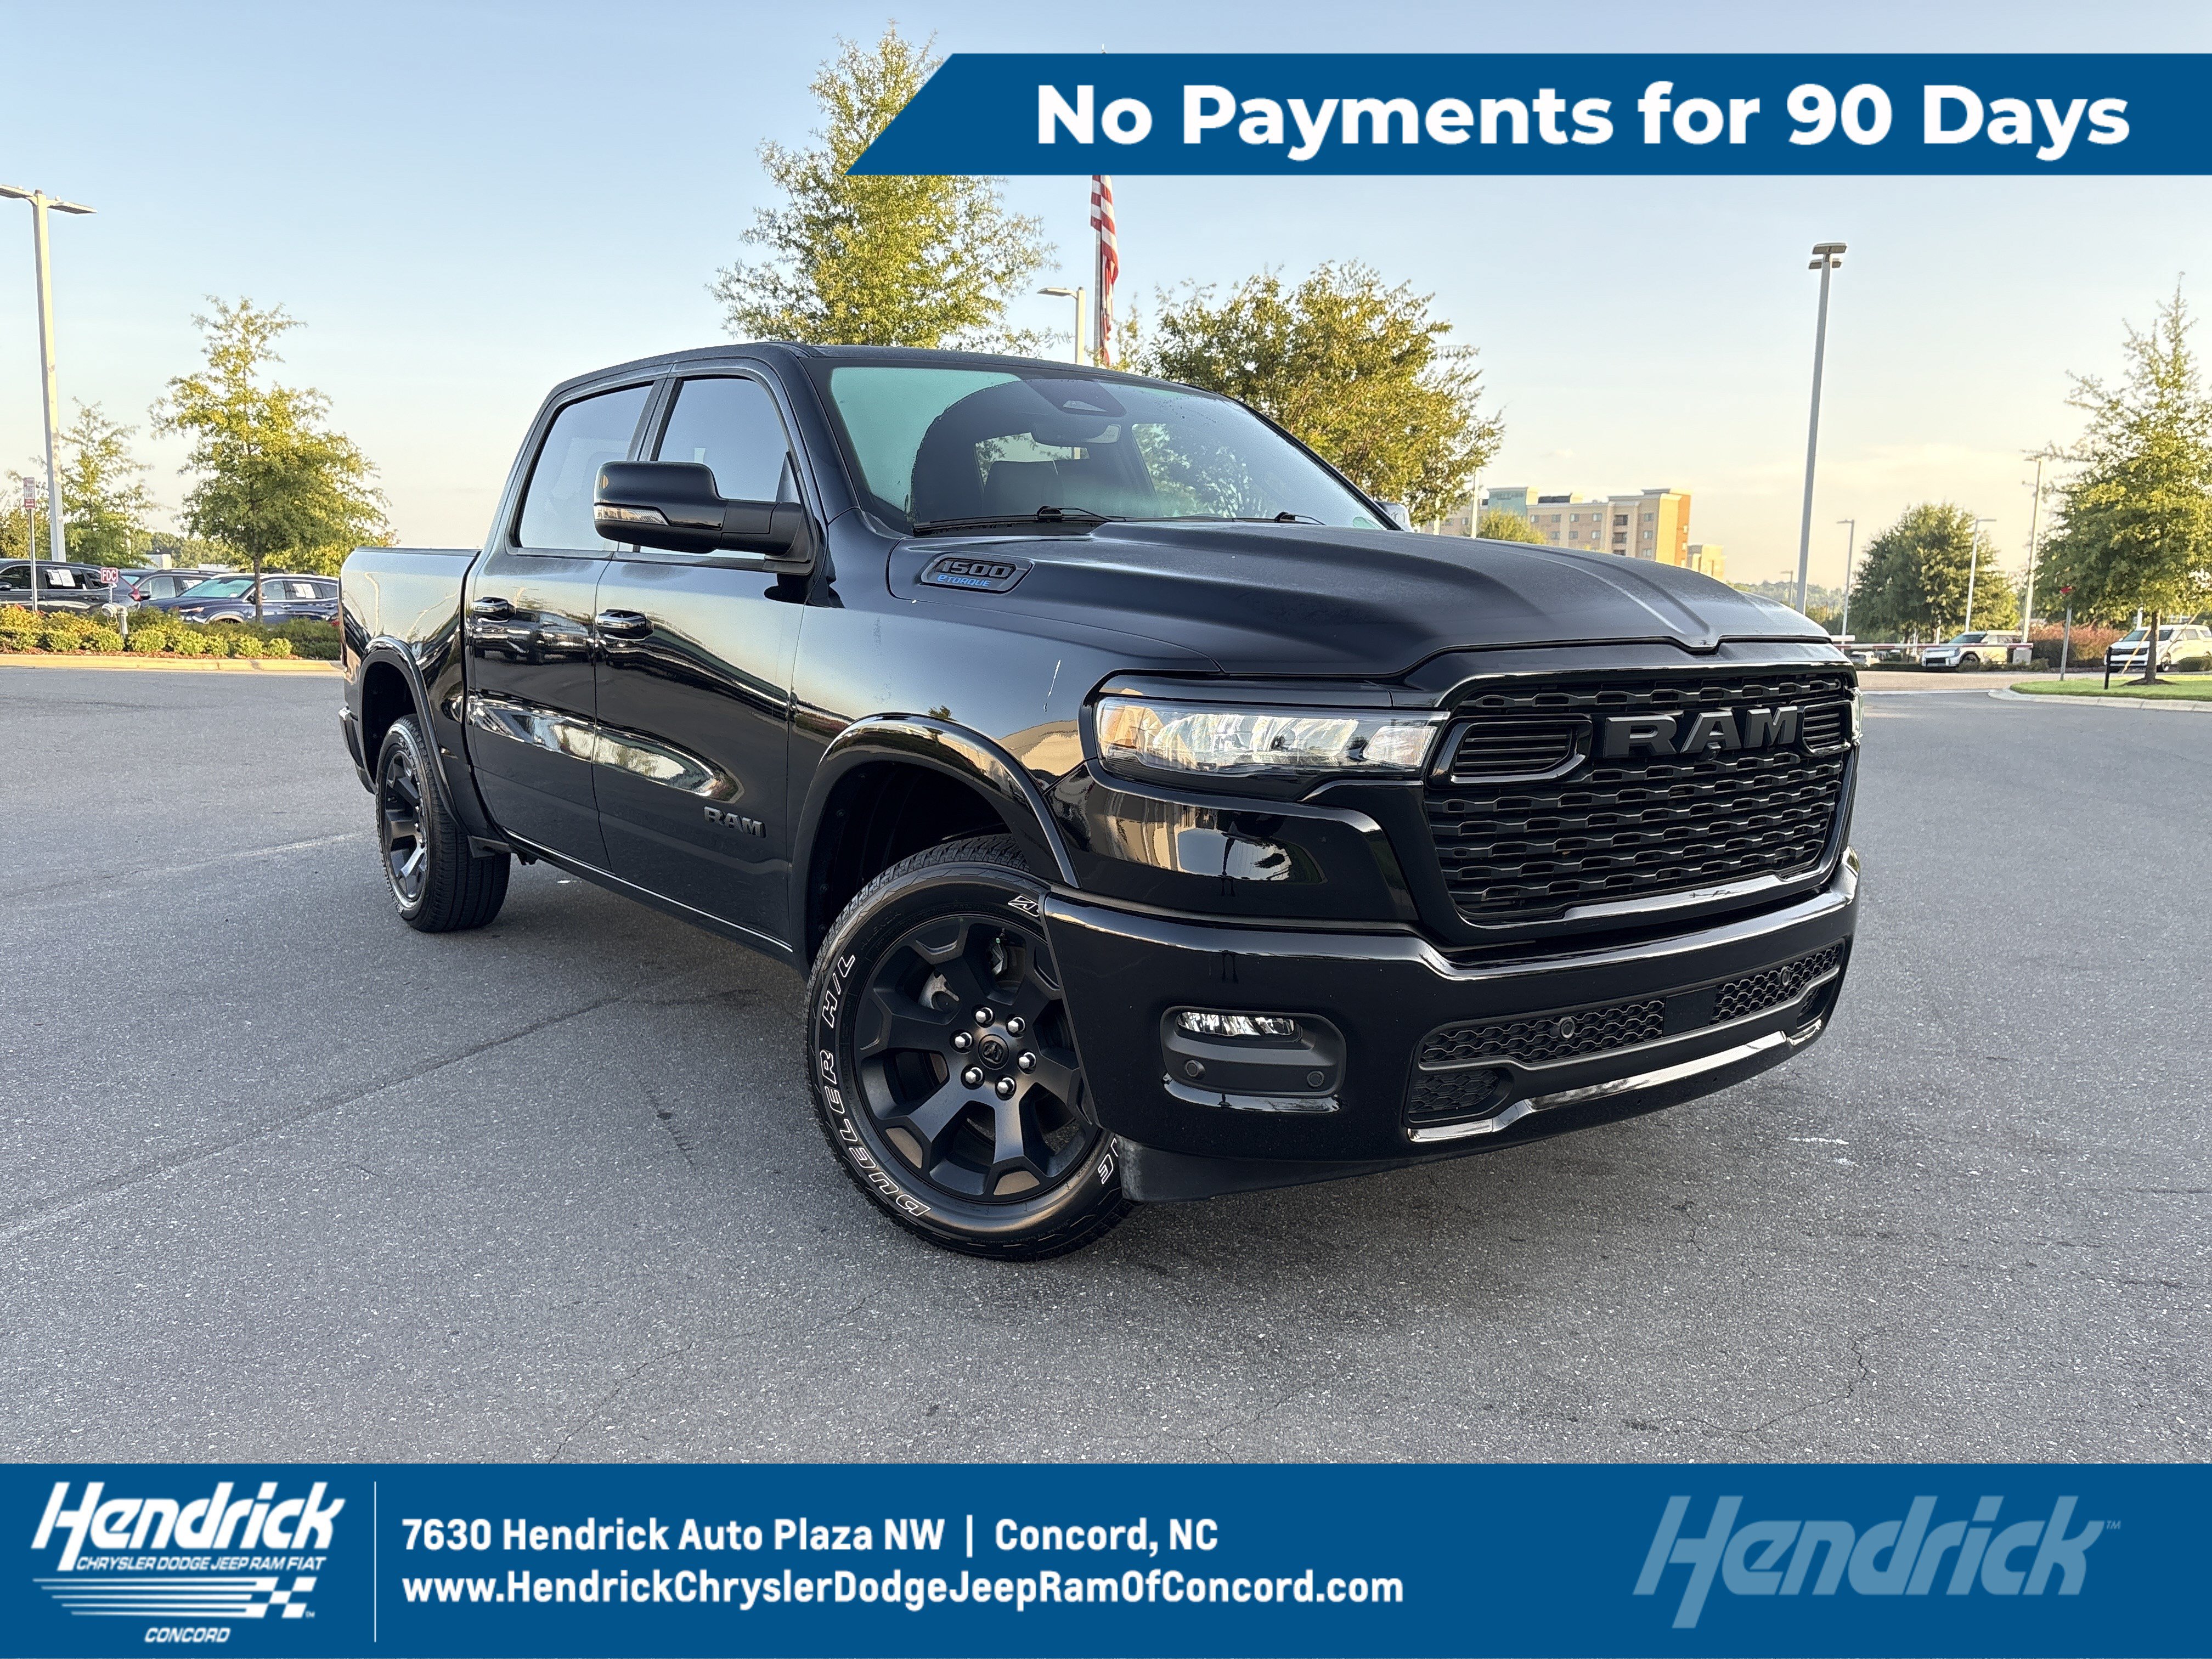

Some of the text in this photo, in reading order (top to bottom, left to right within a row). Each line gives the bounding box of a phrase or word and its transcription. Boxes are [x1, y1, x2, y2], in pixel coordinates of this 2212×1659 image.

[102, 569, 116, 582] FDC
[940, 560, 1013, 578] 1500
[1603, 706, 1799, 759] RAM
[703, 805, 767, 839] RAM
[820, 1049, 932, 1217] DUELER
